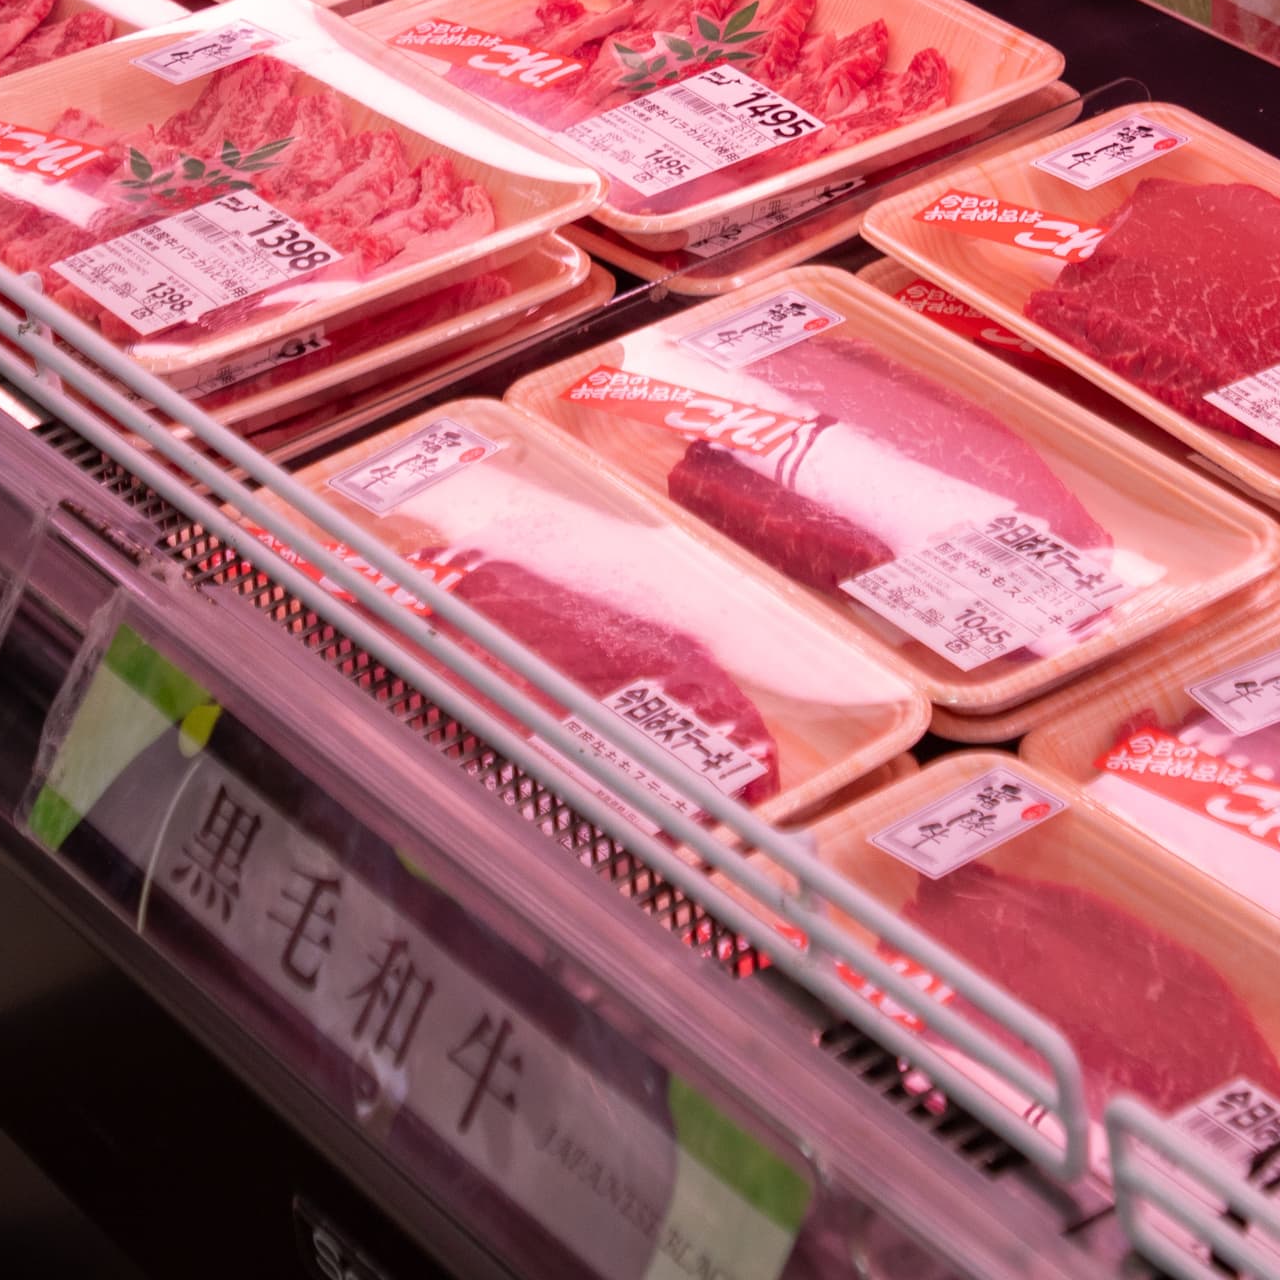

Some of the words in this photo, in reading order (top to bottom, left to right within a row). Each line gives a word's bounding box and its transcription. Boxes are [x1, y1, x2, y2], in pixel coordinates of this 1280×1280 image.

[733, 91, 817, 139] 1495
[644, 149, 690, 177] 1495
[924, 206, 1043, 223] おすすめ品は
[940, 195, 999, 209] 今日の
[247, 218, 332, 271] 1398
[1014, 221, 1107, 258] これ
[146, 281, 193, 313] 1398
[571, 384, 695, 401] おすすめ品は
[589, 371, 650, 385] 今日の
[985, 516, 1124, 599] 今日はステーキ!
[955, 609, 1013, 645] 1045
[615, 688, 752, 780] 今日はステーキ!
[1127, 733, 1198, 758] 今日の
[1104, 750, 1244, 786] おすすめ品は
[171, 786, 522, 1135] 黒毛和牛
